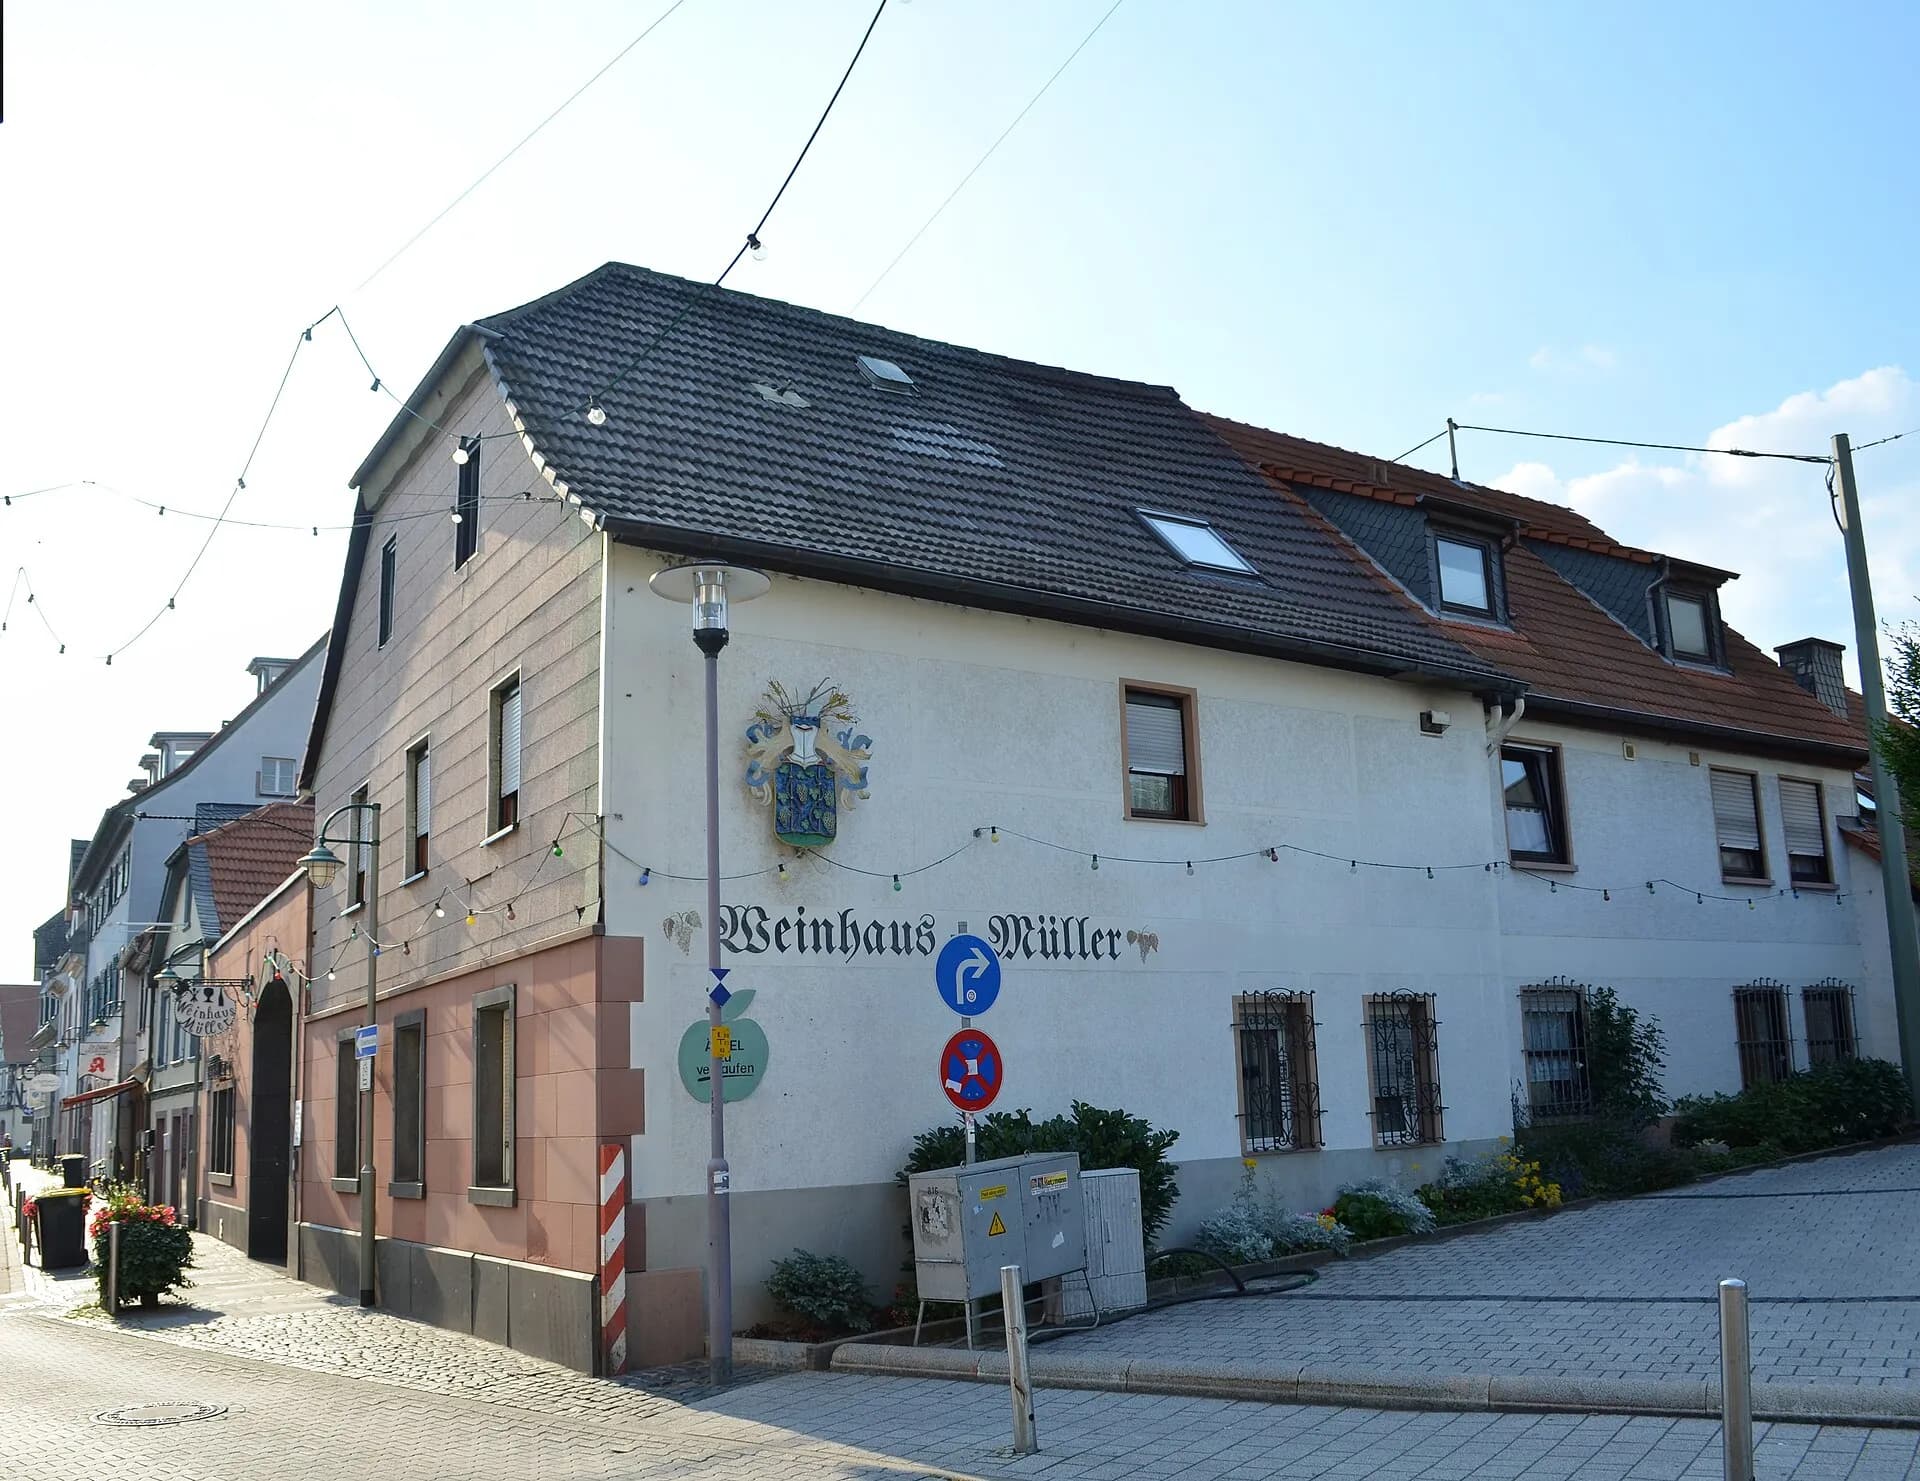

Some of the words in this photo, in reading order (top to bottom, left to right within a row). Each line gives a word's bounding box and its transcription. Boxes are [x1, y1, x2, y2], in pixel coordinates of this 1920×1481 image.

[719, 904, 936, 964] Weinhaus
[988, 914, 1122, 960] Müller
[176, 1000, 236, 1019] Weinhaus
[183, 1017, 235, 1035] Müller
[696, 1063, 754, 1074] veaufen
